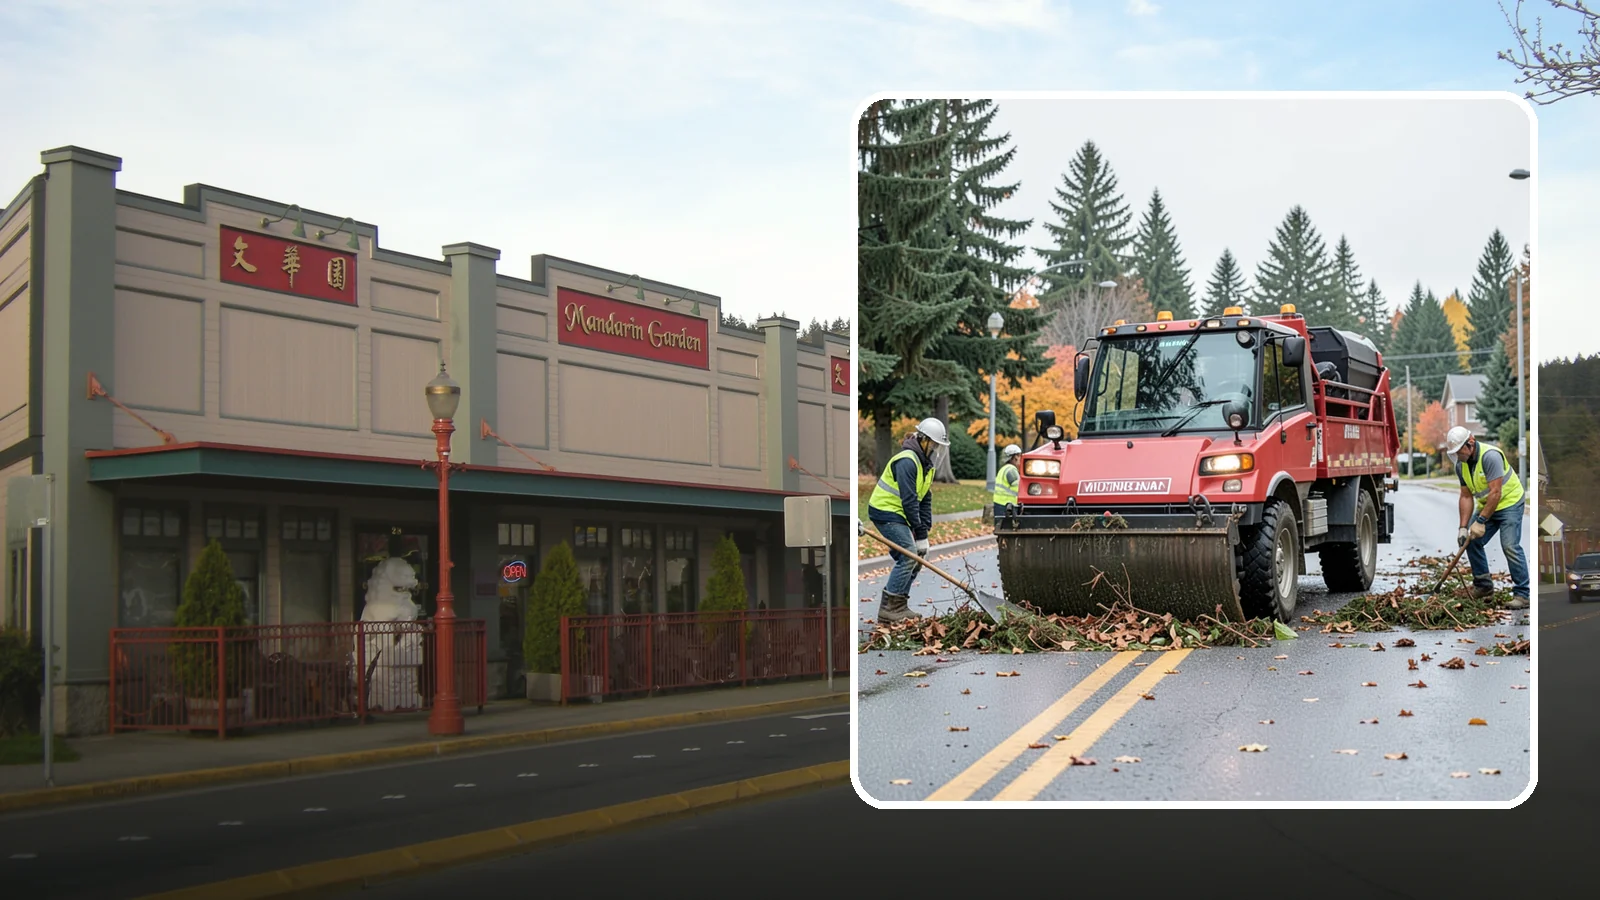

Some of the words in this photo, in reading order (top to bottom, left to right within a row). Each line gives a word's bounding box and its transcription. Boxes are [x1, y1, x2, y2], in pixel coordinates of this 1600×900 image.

[231, 235, 346, 290] 文華園
[564, 302, 644, 341] Mandarin
[648, 320, 701, 352] Garden
[503, 565, 527, 578] OPEN
